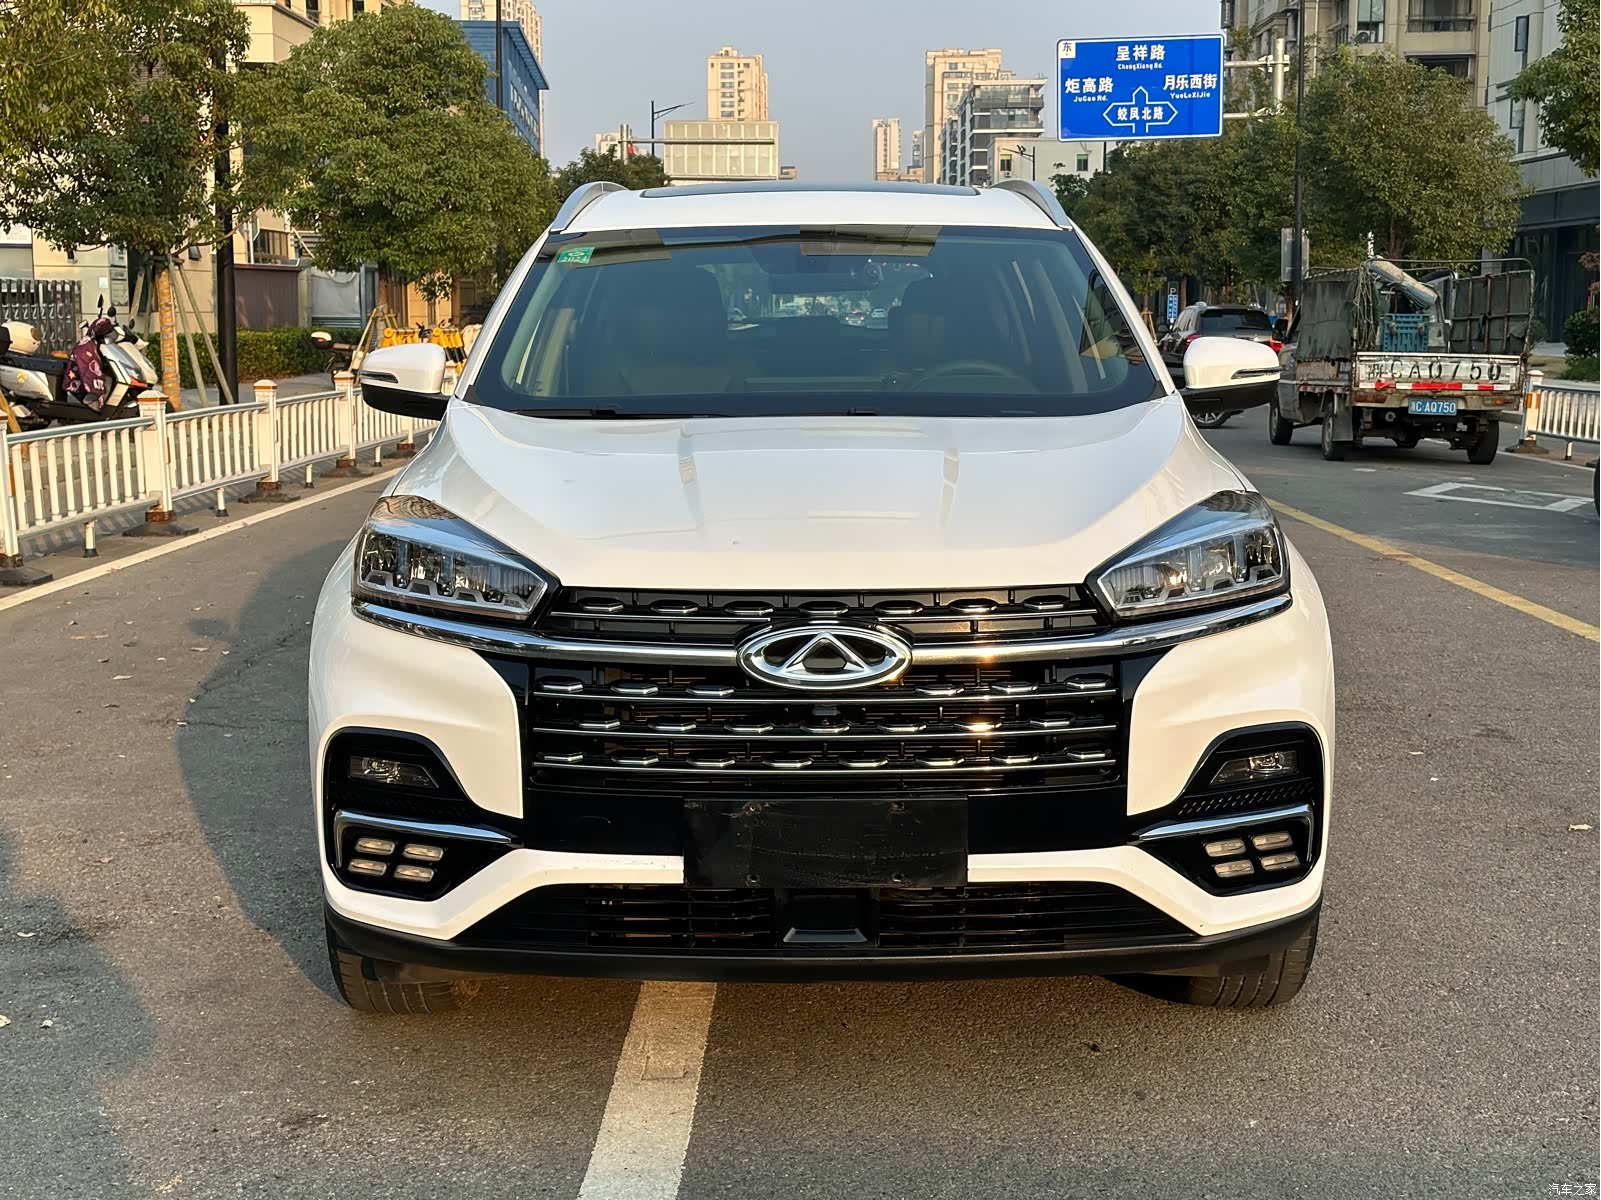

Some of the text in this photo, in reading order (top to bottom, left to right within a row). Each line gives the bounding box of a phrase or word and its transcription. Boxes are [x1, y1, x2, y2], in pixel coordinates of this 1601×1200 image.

[1062, 41, 1073, 52] 东
[1116, 44, 1165, 61] 呈祥路
[1065, 76, 1114, 93] 炬高路
[1163, 73, 1217, 90] 月乐西街
[1117, 106, 1163, 120] 蛟凤北路
